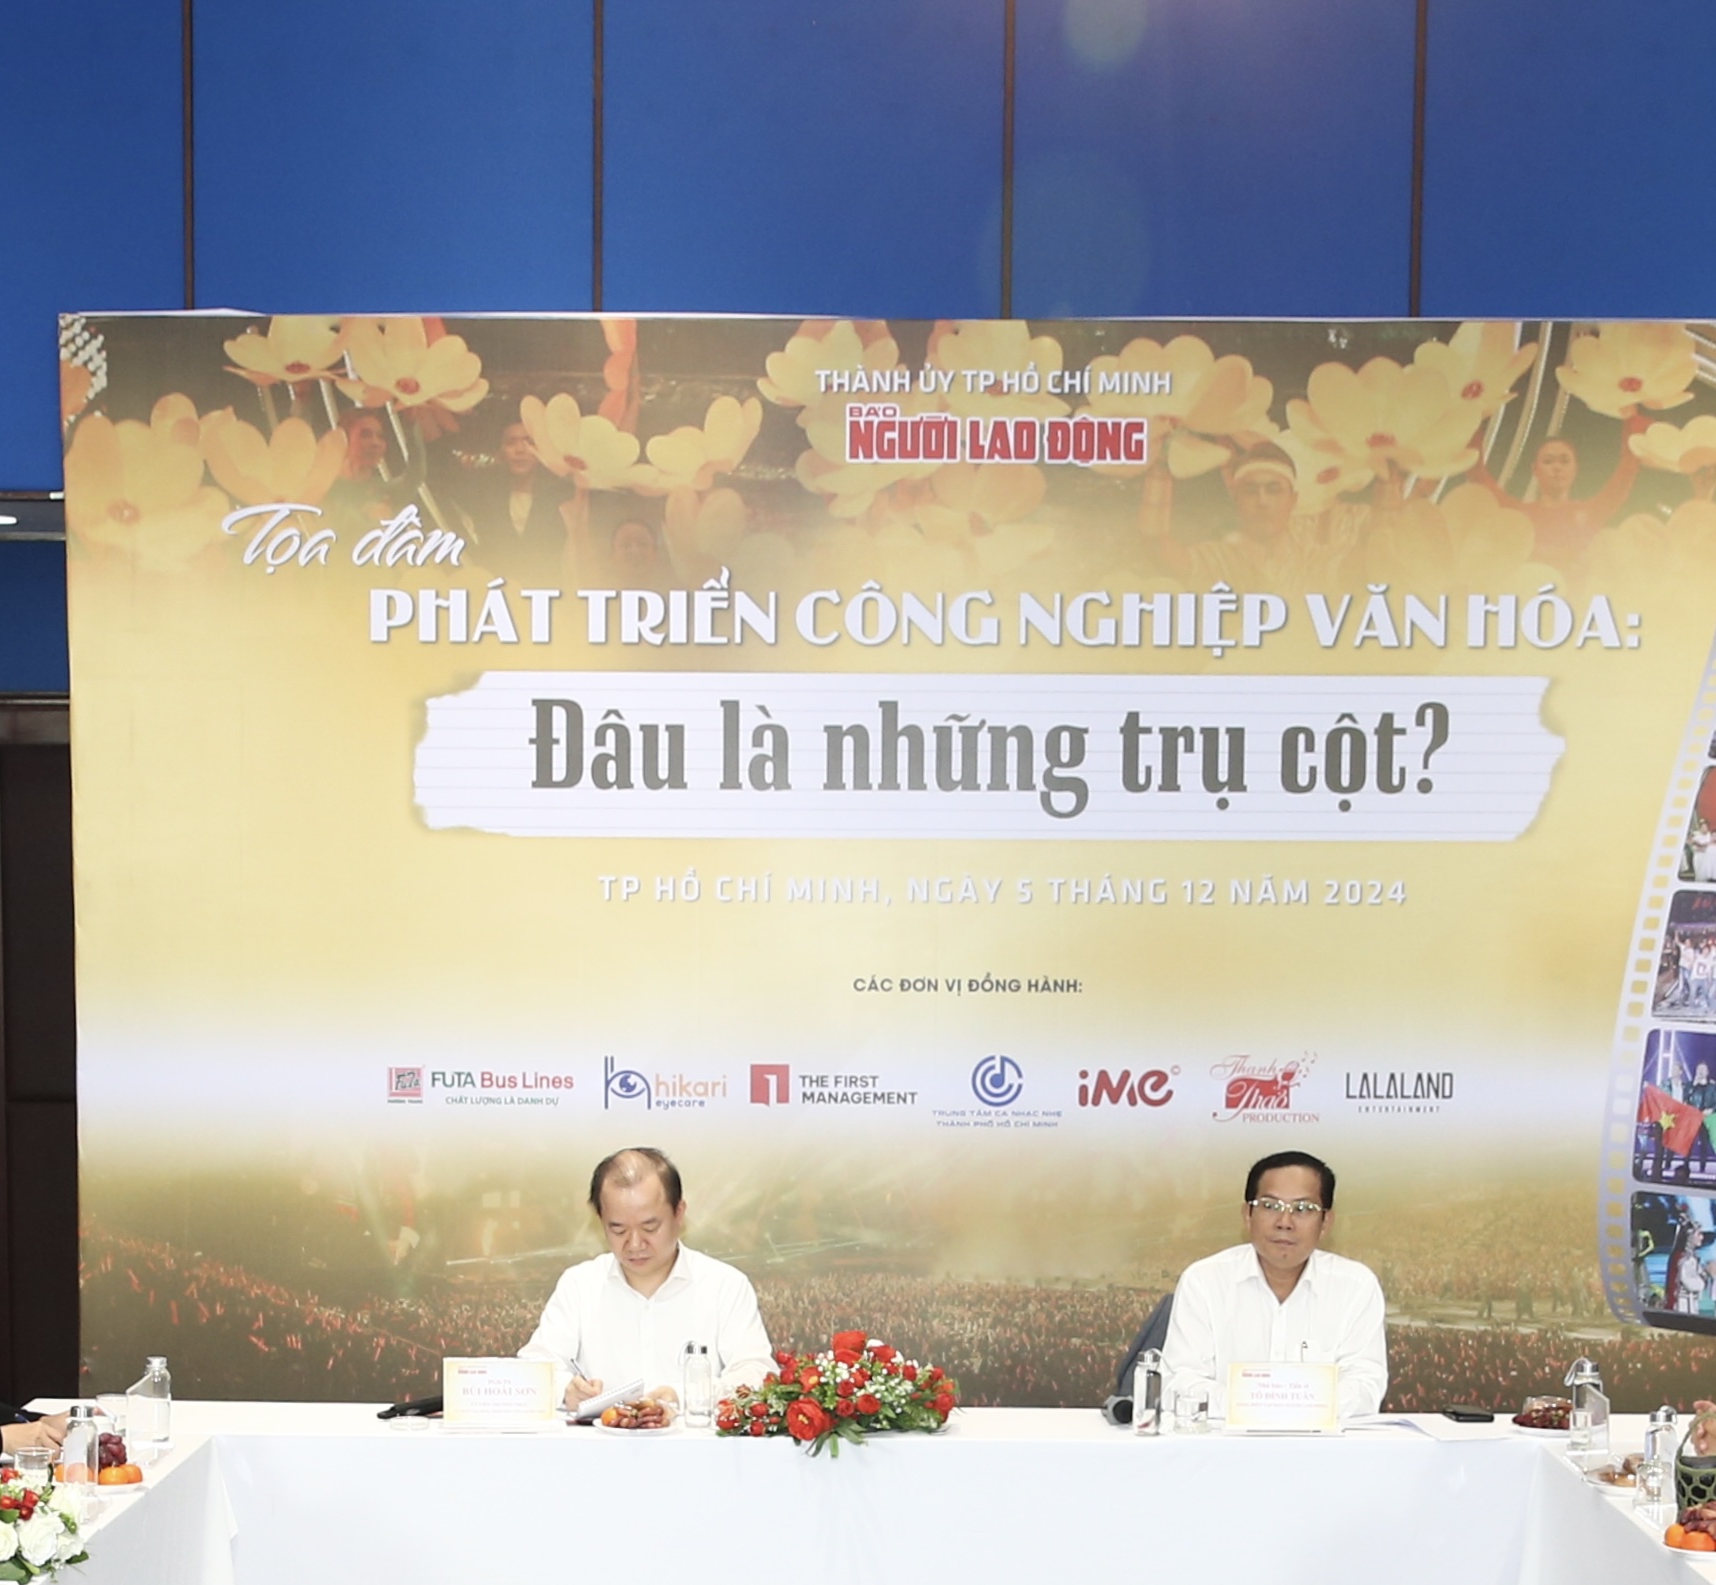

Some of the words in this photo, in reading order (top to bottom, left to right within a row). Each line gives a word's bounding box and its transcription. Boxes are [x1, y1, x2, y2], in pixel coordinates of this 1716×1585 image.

[815, 367, 911, 394] THÀNH
[919, 364, 955, 394] ỦY
[962, 371, 995, 394] TP
[1003, 362, 1040, 395] HỒ
[1047, 367, 1092, 395] CHÍ
[1099, 371, 1172, 395] MINH
[848, 413, 959, 461] NGƯỜI
[968, 419, 1037, 461] LAO
[1047, 416, 1145, 464] ĐỘNG
[221, 503, 336, 574] Tọa
[368, 576, 562, 644] PHÁT
[577, 566, 778, 646] TRIỂN
[795, 581, 999, 646] CÔNG
[1019, 582, 1287, 658] NGHIỆP
[1306, 584, 1448, 650] VĂN
[1466, 588, 1643, 650] HÓA:
[529, 698, 687, 792] Đâu
[720, 700, 793, 792] là
[822, 701, 1089, 819] những
[1120, 711, 1247, 813] trụ
[1283, 701, 1452, 814] cột?
[598, 876, 643, 902] TP
[655, 867, 701, 903] HỒ
[716, 871, 773, 903] CHÍ
[787, 876, 892, 908] MINH,
[907, 873, 1003, 905] NGÀY
[1016, 879, 1034, 905] 5
[1047, 873, 1168, 905] THÁNG
[1182, 880, 1216, 905] 12
[1229, 872, 1311, 905] NĂM
[1324, 880, 1409, 906] 2024
[853, 974, 893, 993] CÁC
[899, 977, 939, 993] ĐƠN
[945, 978, 962, 996] VỊ
[968, 971, 1022, 994] ĐỒNG
[1027, 974, 1084, 994] HÀNH:
[431, 1071, 476, 1088] FUTA
[480, 1071, 518, 1089] Bus
[522, 1071, 575, 1089] Lines
[655, 1073, 728, 1098] hikari
[799, 1075, 830, 1089] THE
[834, 1075, 880, 1089] FIRST
[1345, 1072, 1454, 1100] LALALAND
[655, 1099, 706, 1111] eyecare
[801, 1091, 919, 1105] MANAGEMENT
[1358, 1105, 1441, 1114] ENTERTAINMENT
[1242, 1112, 1321, 1123] PRODUCTION
